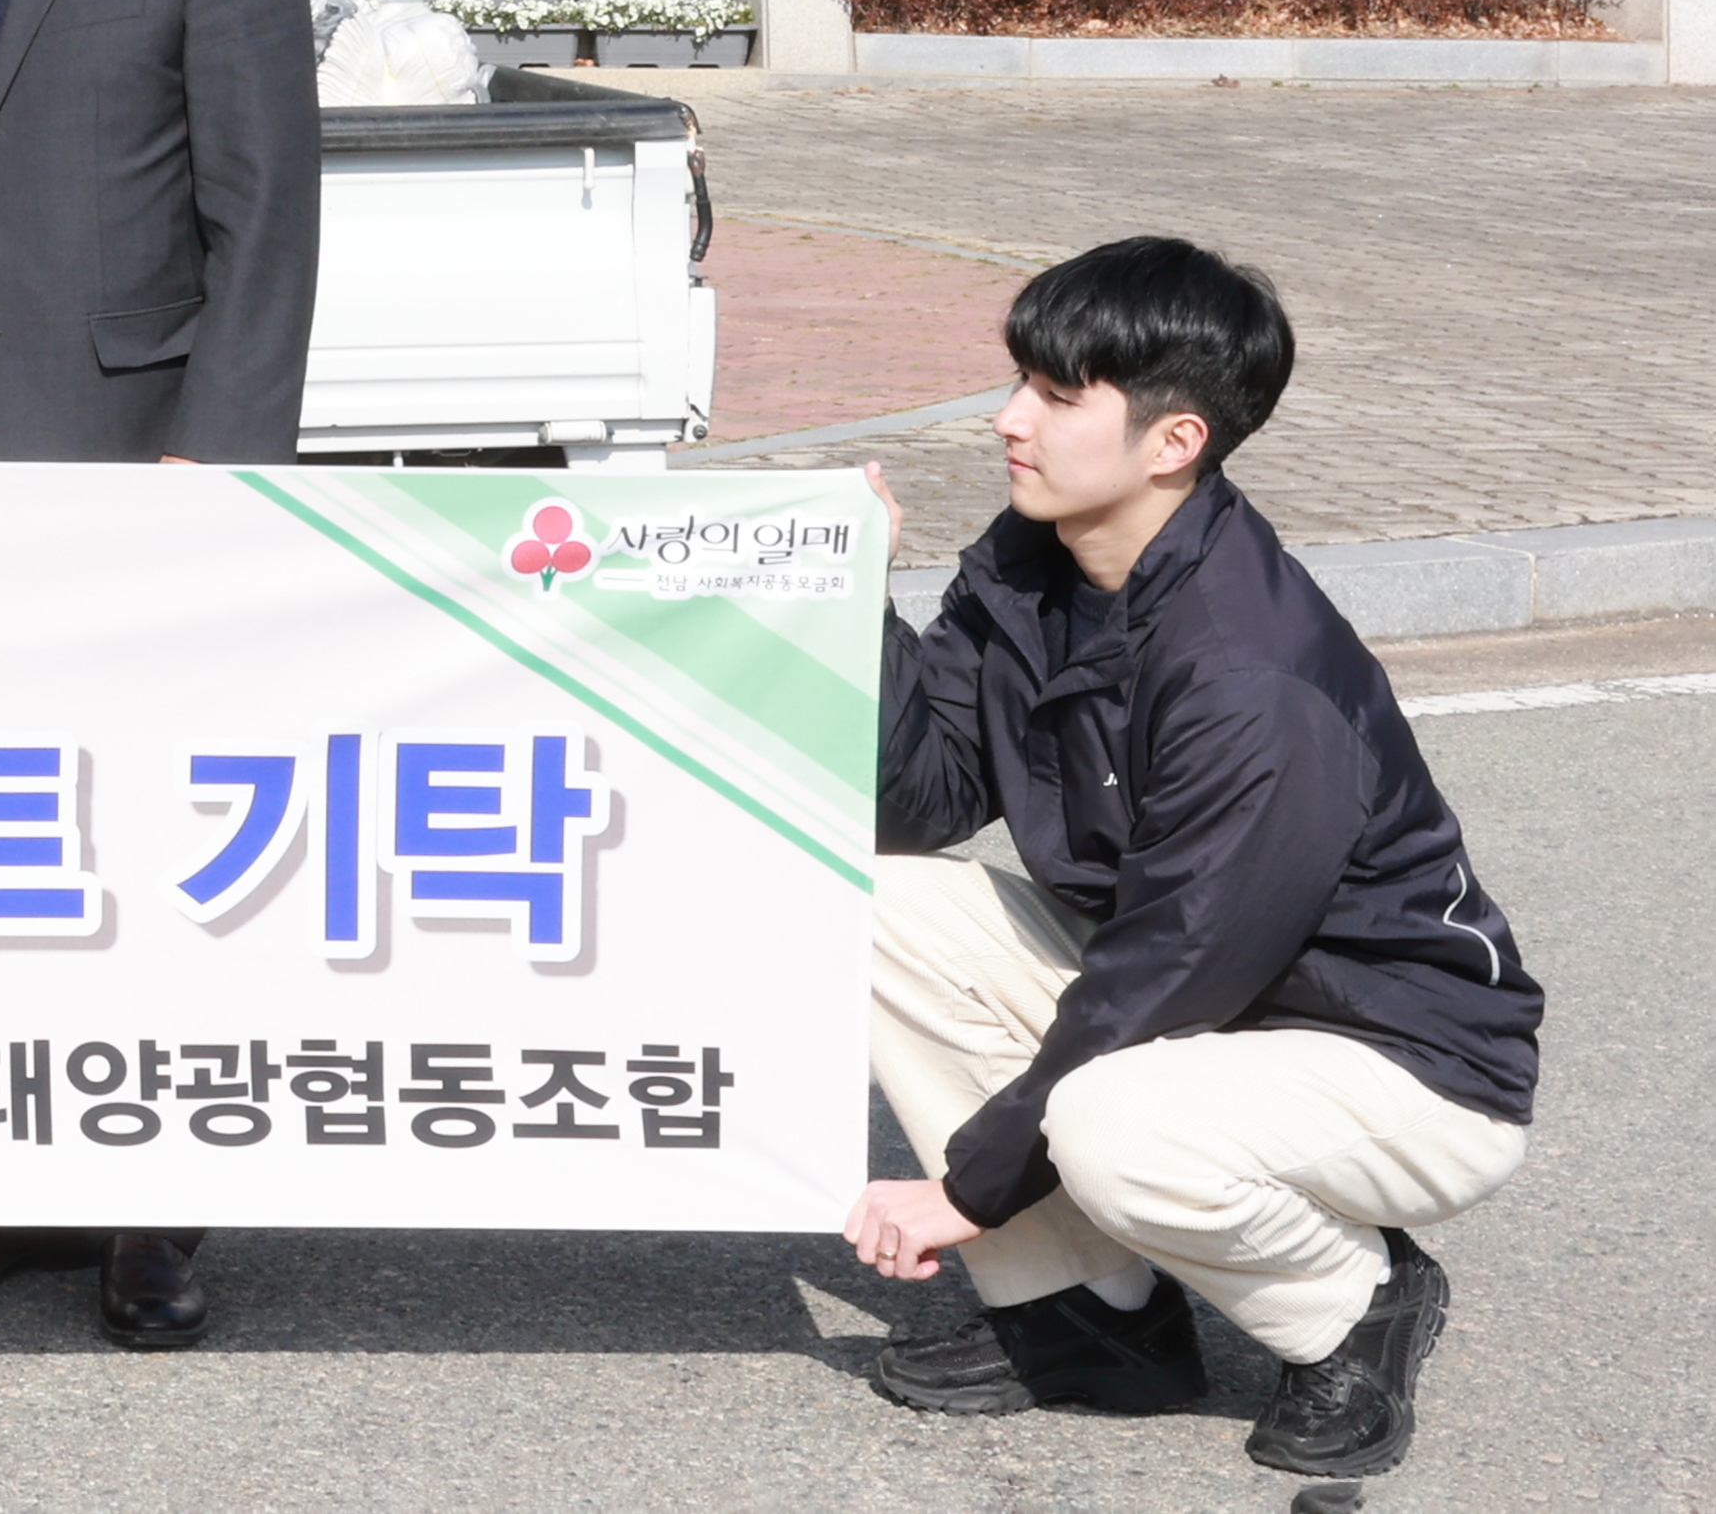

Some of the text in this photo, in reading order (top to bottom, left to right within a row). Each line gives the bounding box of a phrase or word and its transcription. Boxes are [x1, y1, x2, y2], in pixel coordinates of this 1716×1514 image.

[606, 514, 851, 566] 사랑의 열매
[655, 572, 846, 594] 전남 사회복지공동모금회
[181, 735, 590, 945] 기탁
